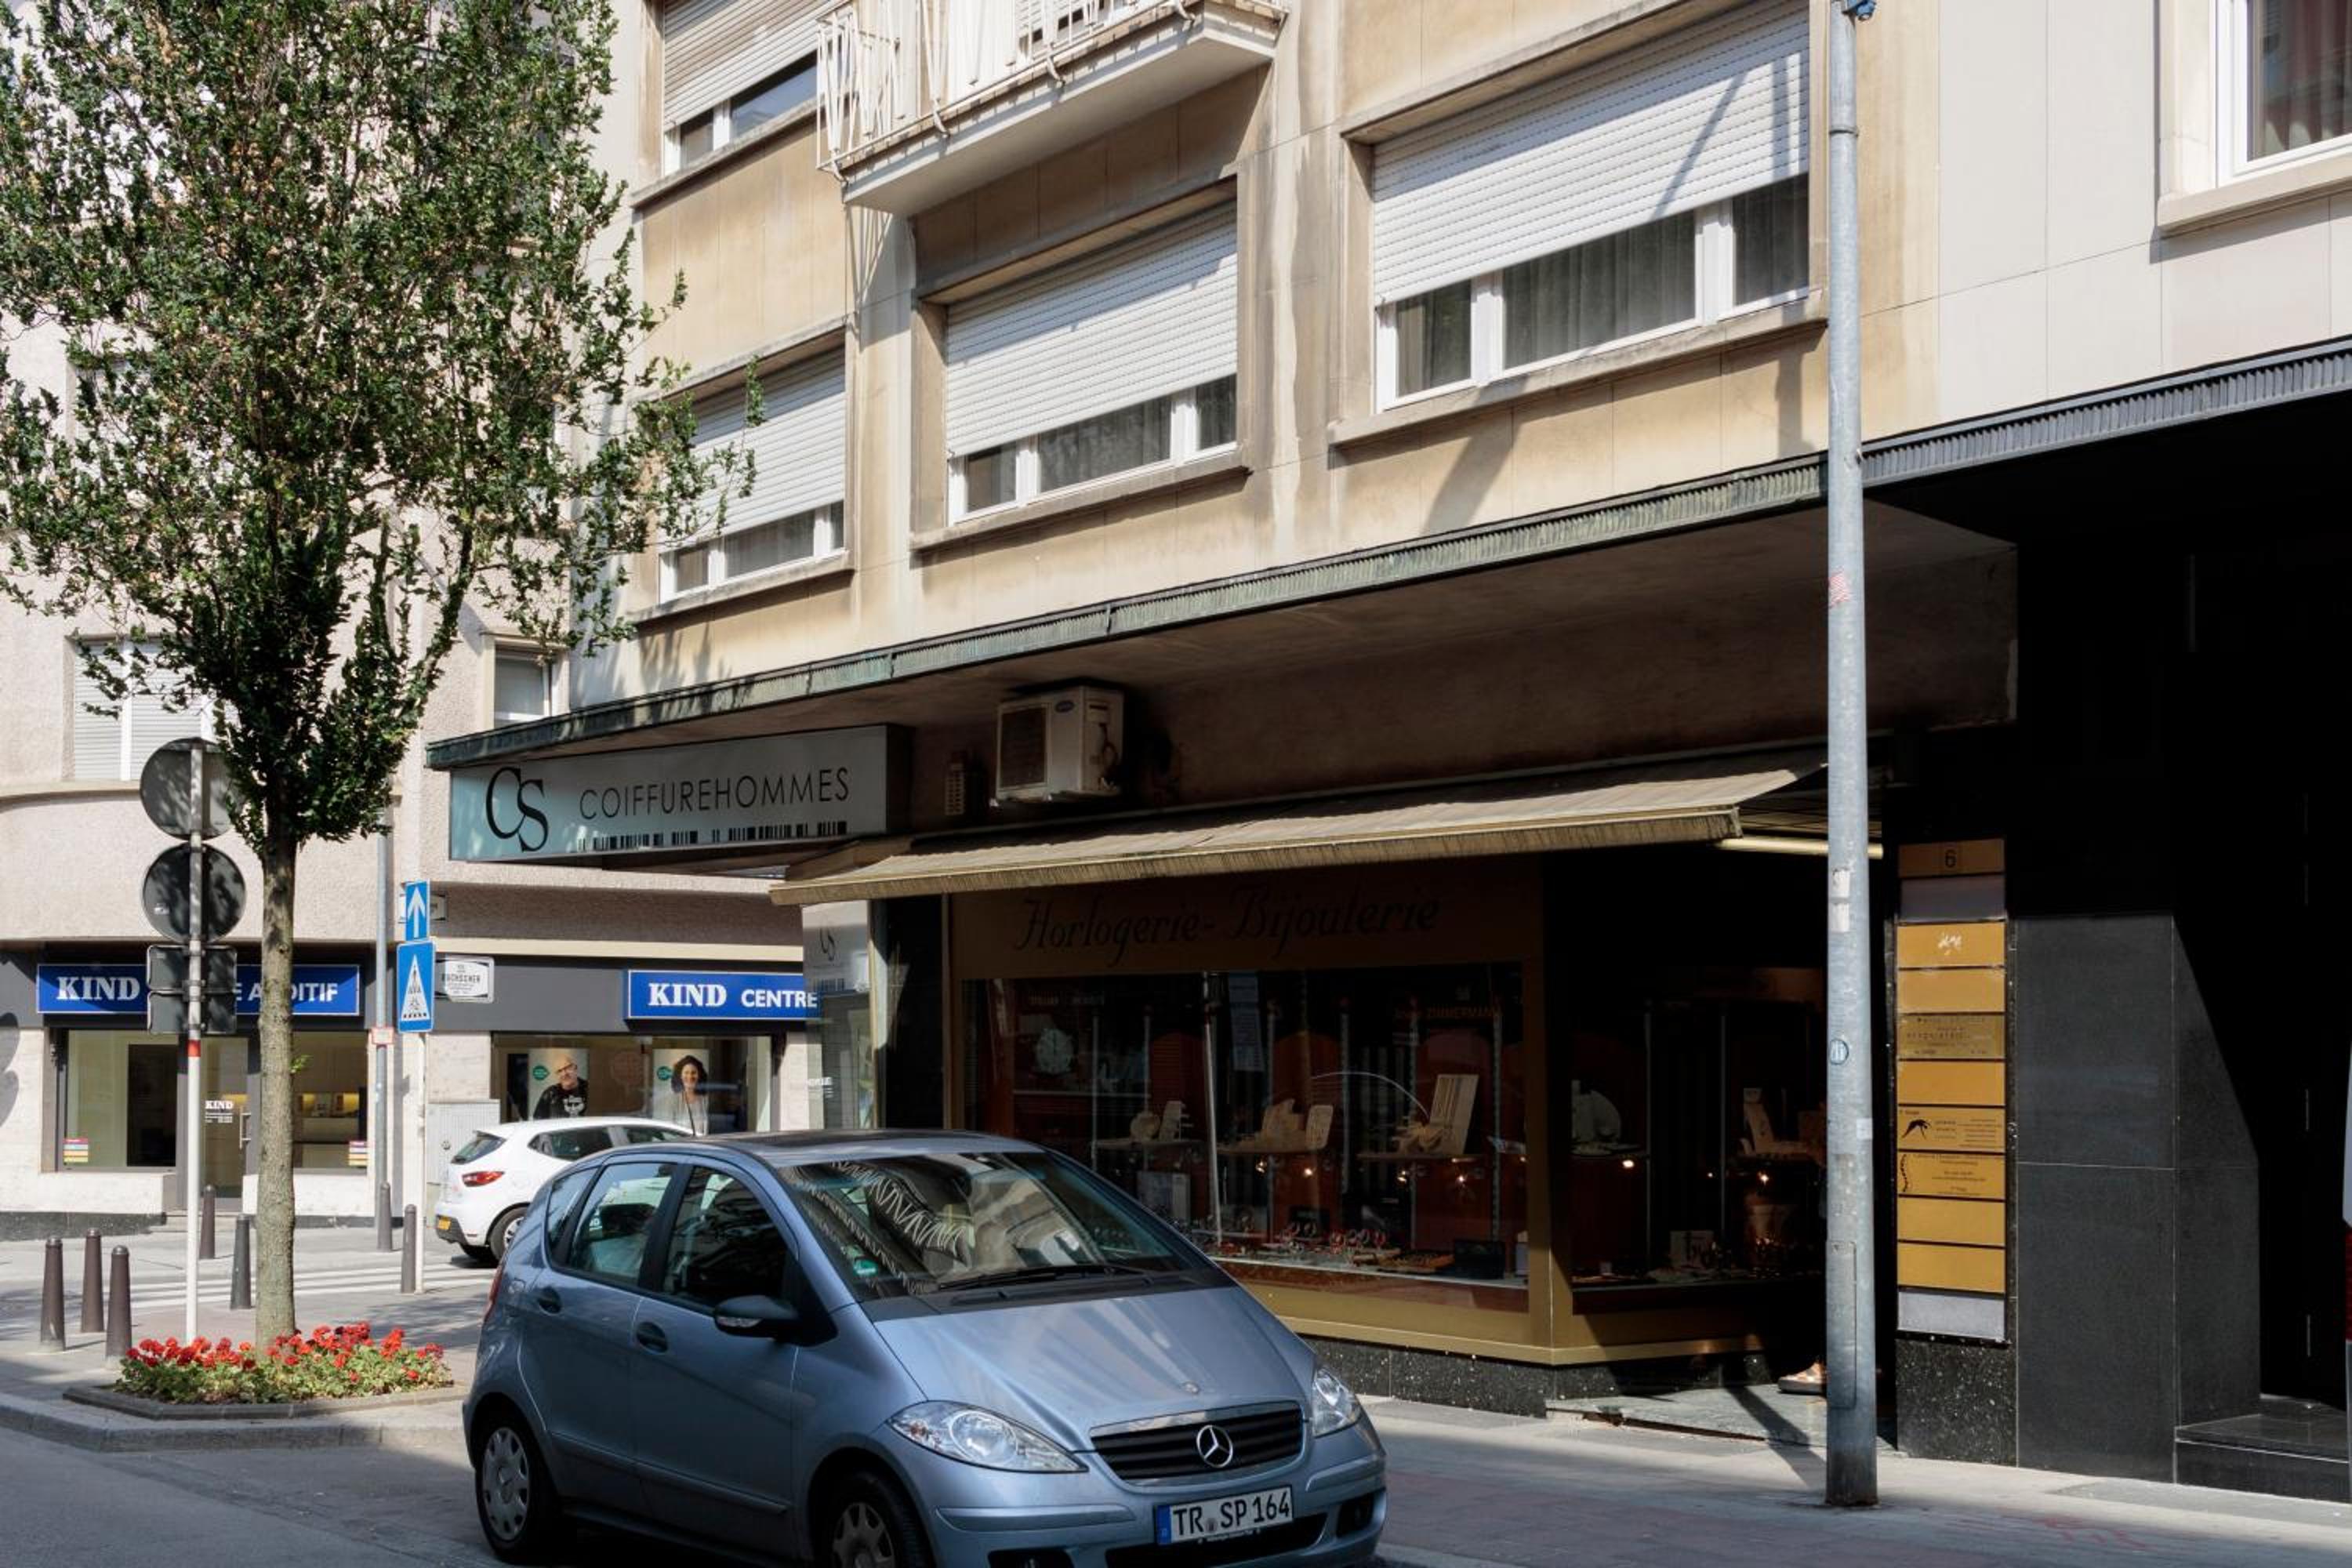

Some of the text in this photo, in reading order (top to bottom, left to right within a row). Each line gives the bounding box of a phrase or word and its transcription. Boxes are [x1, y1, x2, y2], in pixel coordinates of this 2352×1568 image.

[485, 766, 550, 853] CS
[579, 766, 850, 821] COIFFUREHOMMES
[1944, 849, 1957, 868] 6
[1228, 881, 1442, 961] Bijouterie
[56, 976, 140, 1001] KIND
[648, 982, 818, 1010] KIND CENTRE
[205, 1100, 234, 1110] KIND
[1172, 1506, 1204, 1536] TR
[1220, 1499, 1247, 1529] SP
[1252, 1490, 1290, 1523] 164
